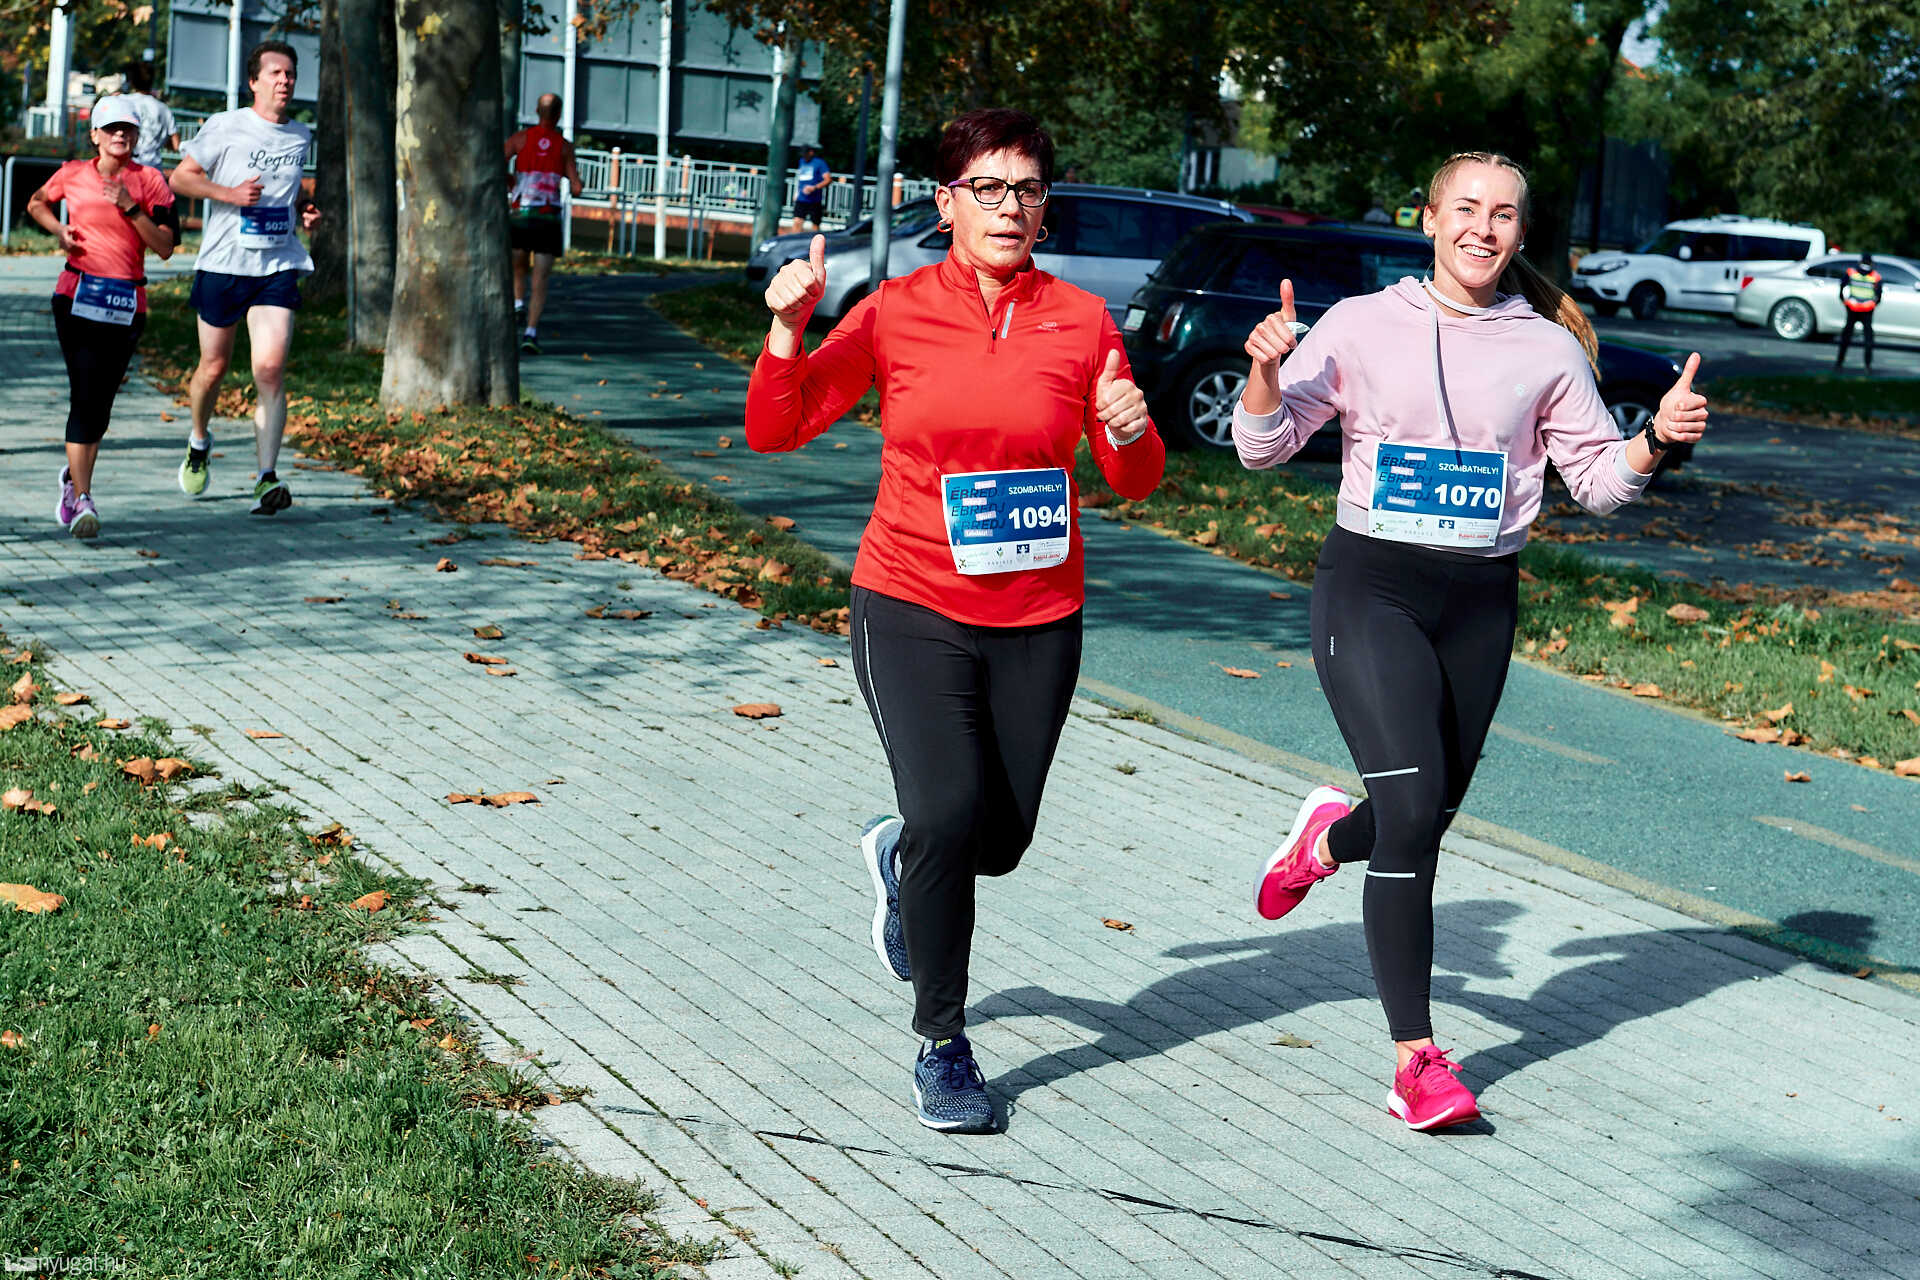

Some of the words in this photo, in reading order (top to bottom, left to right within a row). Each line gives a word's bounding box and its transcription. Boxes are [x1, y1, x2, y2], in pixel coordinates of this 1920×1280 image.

[105, 294, 135, 309] 1053
[1438, 462, 1499, 475] SZOMBATHELY!
[1008, 484, 1063, 495] SZOMBATHELY!
[1434, 483, 1502, 508] 1070
[1008, 504, 1067, 530] 1094
